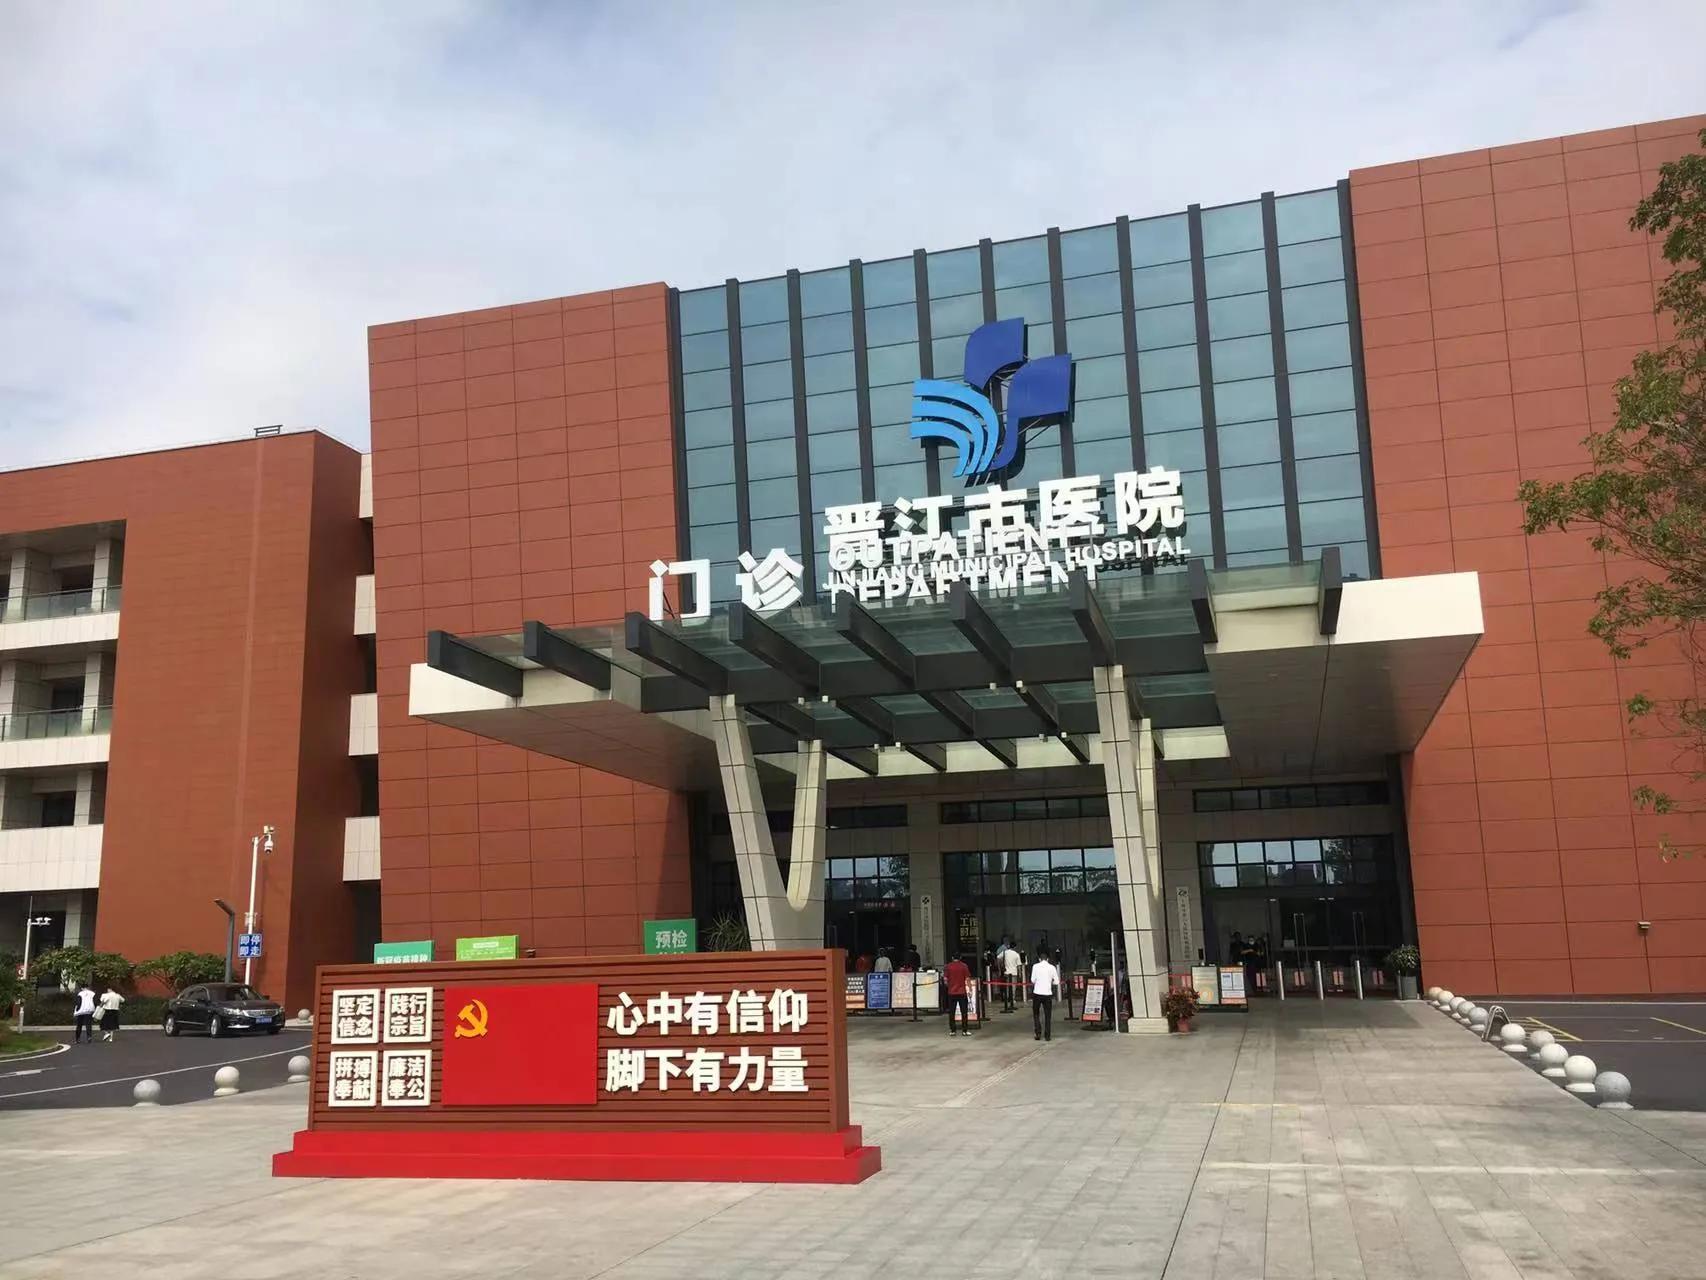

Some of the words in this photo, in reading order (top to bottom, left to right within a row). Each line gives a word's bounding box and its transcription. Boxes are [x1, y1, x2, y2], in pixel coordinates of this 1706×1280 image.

[824, 466, 1185, 559] 晋江市医院
[930, 550, 1057, 579] MUNICIPAL
[1065, 536, 1191, 566] HOSPITAL
[648, 548, 805, 620] 门诊
[240, 935, 260, 945] 即停
[655, 930, 688, 949] 预检
[239, 946, 259, 956] 即走
[339, 995, 373, 1016] 坚定
[391, 994, 426, 1014] 践行
[606, 988, 809, 1036] 心中有信仰
[338, 1016, 373, 1036] 信念
[390, 1015, 425, 1035] 宗旨
[335, 1058, 371, 1078] 拼搏
[389, 1057, 424, 1077] 廉洁
[605, 1046, 809, 1093] 脚下有力量
[335, 1079, 370, 1099] 奉献
[388, 1078, 424, 1099] 奉公
